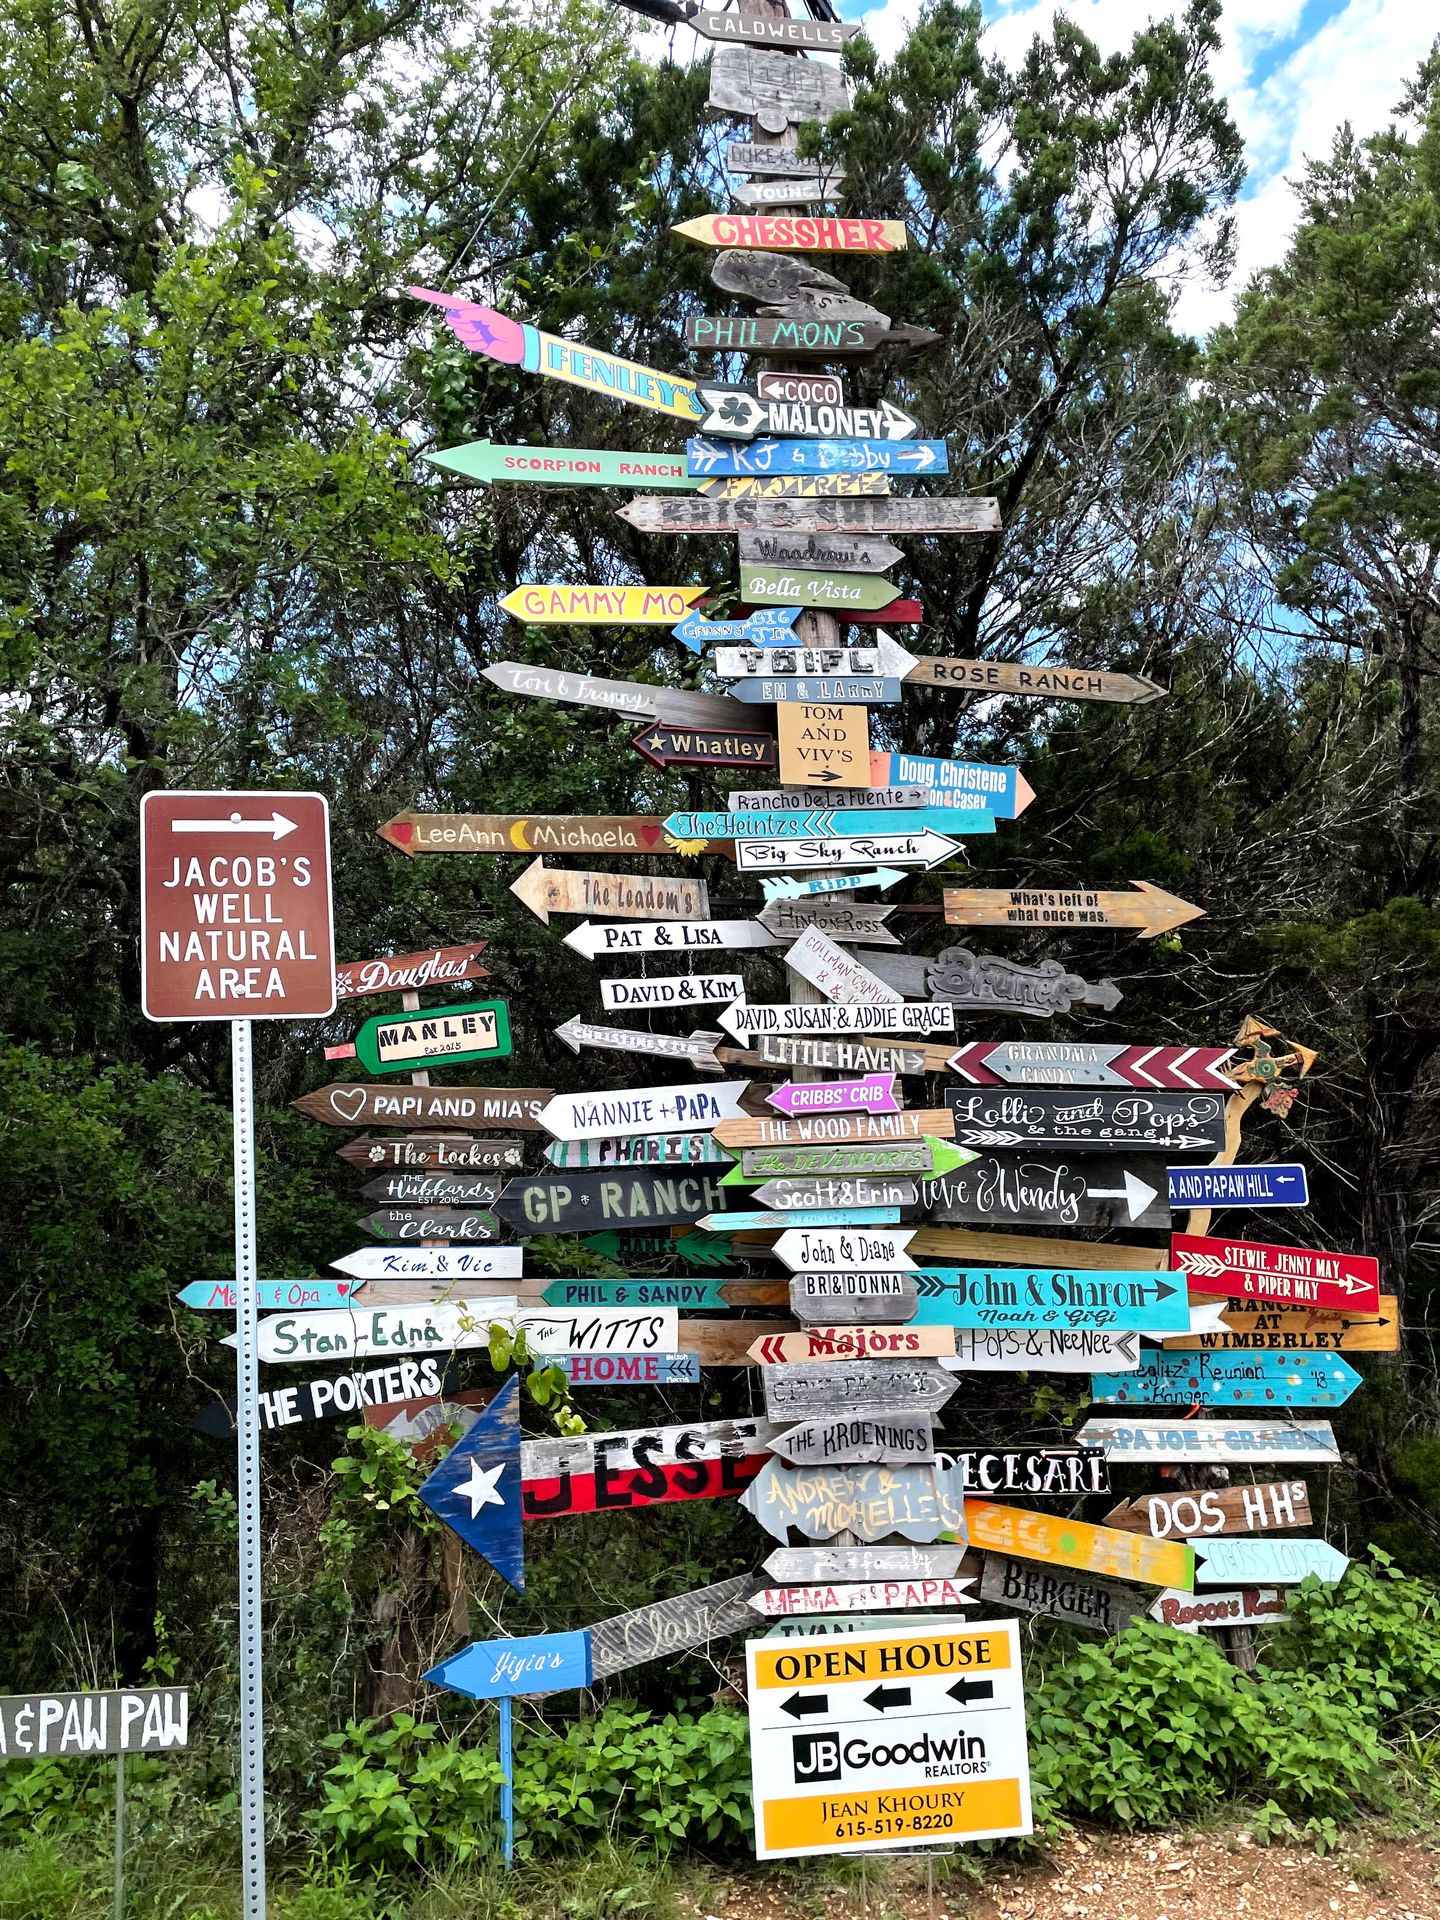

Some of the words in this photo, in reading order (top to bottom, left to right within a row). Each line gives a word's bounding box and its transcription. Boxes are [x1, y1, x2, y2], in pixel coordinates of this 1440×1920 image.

[708, 16, 843, 43] CALDWELLS
[711, 216, 893, 250] CHESSHER
[694, 318, 761, 345] PHIL
[772, 321, 866, 346] MON'S
[784, 381, 838, 404] COCO
[769, 403, 884, 441] MALONEY
[504, 456, 601, 473] SCORPION
[619, 462, 683, 478] RANCH
[750, 577, 802, 599] Bella
[807, 580, 862, 601] Vista
[524, 590, 628, 616] GAMMY
[642, 592, 686, 616] MO
[752, 610, 792, 627] BIG
[752, 627, 799, 644] JIM
[507, 669, 550, 691] Tom
[576, 680, 651, 711] Franny
[821, 681, 885, 700] LARRY
[933, 663, 999, 685] ROSE
[1019, 671, 1103, 694] RANCH
[801, 706, 844, 721] TOM
[801, 727, 847, 742] AND
[671, 734, 766, 762] Whatley
[797, 747, 854, 764] VIV'S
[899, 754, 938, 788] Doug,
[939, 760, 1008, 794] Christene
[738, 795, 800, 811] Rancho
[849, 787, 904, 806] Fuente
[533, 825, 638, 847] Michaela
[744, 845, 789, 862] Big
[795, 841, 845, 861] Sky
[850, 838, 920, 859] Ranch
[162, 856, 312, 888] JACOB'S
[807, 875, 861, 894] Ripp
[193, 893, 283, 924] WELL
[582, 879, 610, 906] The
[617, 881, 694, 915] Leadem's
[1010, 892, 1055, 908] What's
[1059, 891, 1083, 907] left
[1086, 892, 1099, 907] of
[1007, 908, 1040, 922] what
[1043, 908, 1075, 922] once
[159, 930, 318, 962] NATURAL
[604, 928, 642, 947] PAT
[654, 926, 673, 946] &
[682, 925, 724, 945] LISA
[195, 967, 286, 999] AREA
[612, 983, 675, 1004] DAVID
[678, 979, 697, 1000] &
[699, 979, 738, 999] KIM
[735, 1008, 780, 1031] DAVID,
[784, 1007, 831, 1029] SUSAN
[837, 1007, 851, 1028] &
[854, 1007, 897, 1028] ADDIE
[903, 1005, 950, 1031] GRACE
[380, 1015, 495, 1048] MANLEY
[762, 1035, 833, 1067] LITTLE
[838, 1044, 906, 1072] HAVEN
[1007, 1044, 1098, 1062] GRANDMA
[1020, 1065, 1078, 1084] CINDY
[373, 1096, 422, 1117] PAPI
[427, 1097, 476, 1118] AND
[483, 1099, 543, 1119] MIA'S
[791, 1088, 847, 1106] CRIBBS'
[849, 1085, 884, 1103] CRIB
[572, 1100, 653, 1128] NANNIE
[675, 1093, 721, 1121] PAPA
[954, 1096, 1045, 1126] Lolli
[1053, 1097, 1105, 1123] and
[1112, 1096, 1220, 1130] Pops
[758, 1119, 793, 1142] THE
[797, 1117, 851, 1141] WOOD
[856, 1114, 921, 1138] FAMILY
[1052, 1123, 1097, 1136] the
[1099, 1127, 1157, 1139] gang
[389, 1143, 431, 1165] The
[437, 1143, 505, 1167] Lockes
[599, 1135, 704, 1162] PHARIS
[788, 1150, 922, 1171] DEVENPORTS
[386, 1179, 496, 1201] Hubbards
[401, 1174, 425, 1182] THE
[1179, 1175, 1203, 1199] AND
[1204, 1174, 1245, 1198] PAPAW
[1246, 1174, 1274, 1197] HILL
[417, 1196, 435, 1204] EST
[438, 1196, 460, 1204] 2016
[523, 1184, 573, 1224] GP
[600, 1176, 727, 1218] RANCH
[856, 1179, 904, 1205] Erin
[1000, 1163, 1088, 1224] Wendy
[389, 1210, 412, 1221] the
[399, 1217, 492, 1240] Clarks
[801, 1235, 836, 1264] John
[839, 1235, 853, 1262] &
[858, 1236, 895, 1262] Diane
[382, 1254, 429, 1273] Kim
[436, 1254, 449, 1272] &
[457, 1254, 493, 1273] Vic
[1274, 1253, 1313, 1276] JENNY
[1315, 1259, 1340, 1279] MAY
[287, 1284, 320, 1307] Opa
[566, 1285, 607, 1303] PHIL
[615, 1286, 630, 1302] &
[637, 1285, 708, 1303] SANDY
[847, 1274, 901, 1295] DONNA
[952, 1274, 1019, 1307] John
[1024, 1274, 1044, 1307] &
[1051, 1273, 1147, 1308] Sharon
[1258, 1277, 1291, 1298] PIPER
[1294, 1280, 1319, 1301] MAY
[371, 1312, 444, 1349] Edna
[977, 1309, 1038, 1323] Noah
[1063, 1309, 1118, 1327] GiGi
[1253, 1314, 1282, 1330] AT
[537, 1326, 558, 1341] THE
[568, 1316, 664, 1350] WITTS
[807, 1327, 920, 1358] Majors
[1199, 1332, 1345, 1349] WIMBERLEY
[570, 1356, 660, 1381] HOME
[1200, 1352, 1266, 1380] Reunion
[257, 1386, 302, 1430] THE
[309, 1358, 442, 1418] PORTERS
[784, 1428, 816, 1455] THE
[823, 1421, 928, 1456] KROENINGS
[1156, 1430, 1198, 1451] JOE
[523, 1424, 758, 1515] JESSE
[1148, 1490, 1226, 1539] DOS
[1207, 1542, 1269, 1578] CROSS
[1271, 1542, 1335, 1578] LODGE
[764, 1586, 840, 1615] MEMA
[883, 1580, 963, 1607] PAPA
[1001, 1558, 1115, 1631] BERGER
[775, 1648, 867, 1681] OPEN
[878, 1639, 992, 1673] HOUSE
[38, 1696, 108, 1753] PAW
[120, 1691, 188, 1749] PAW
[796, 1737, 840, 1776] JB
[843, 1729, 987, 1770] Goodwin
[821, 1799, 869, 1824] JEAN
[877, 1791, 965, 1815] KHOURY
[835, 1813, 954, 1838] 615-519-8220
